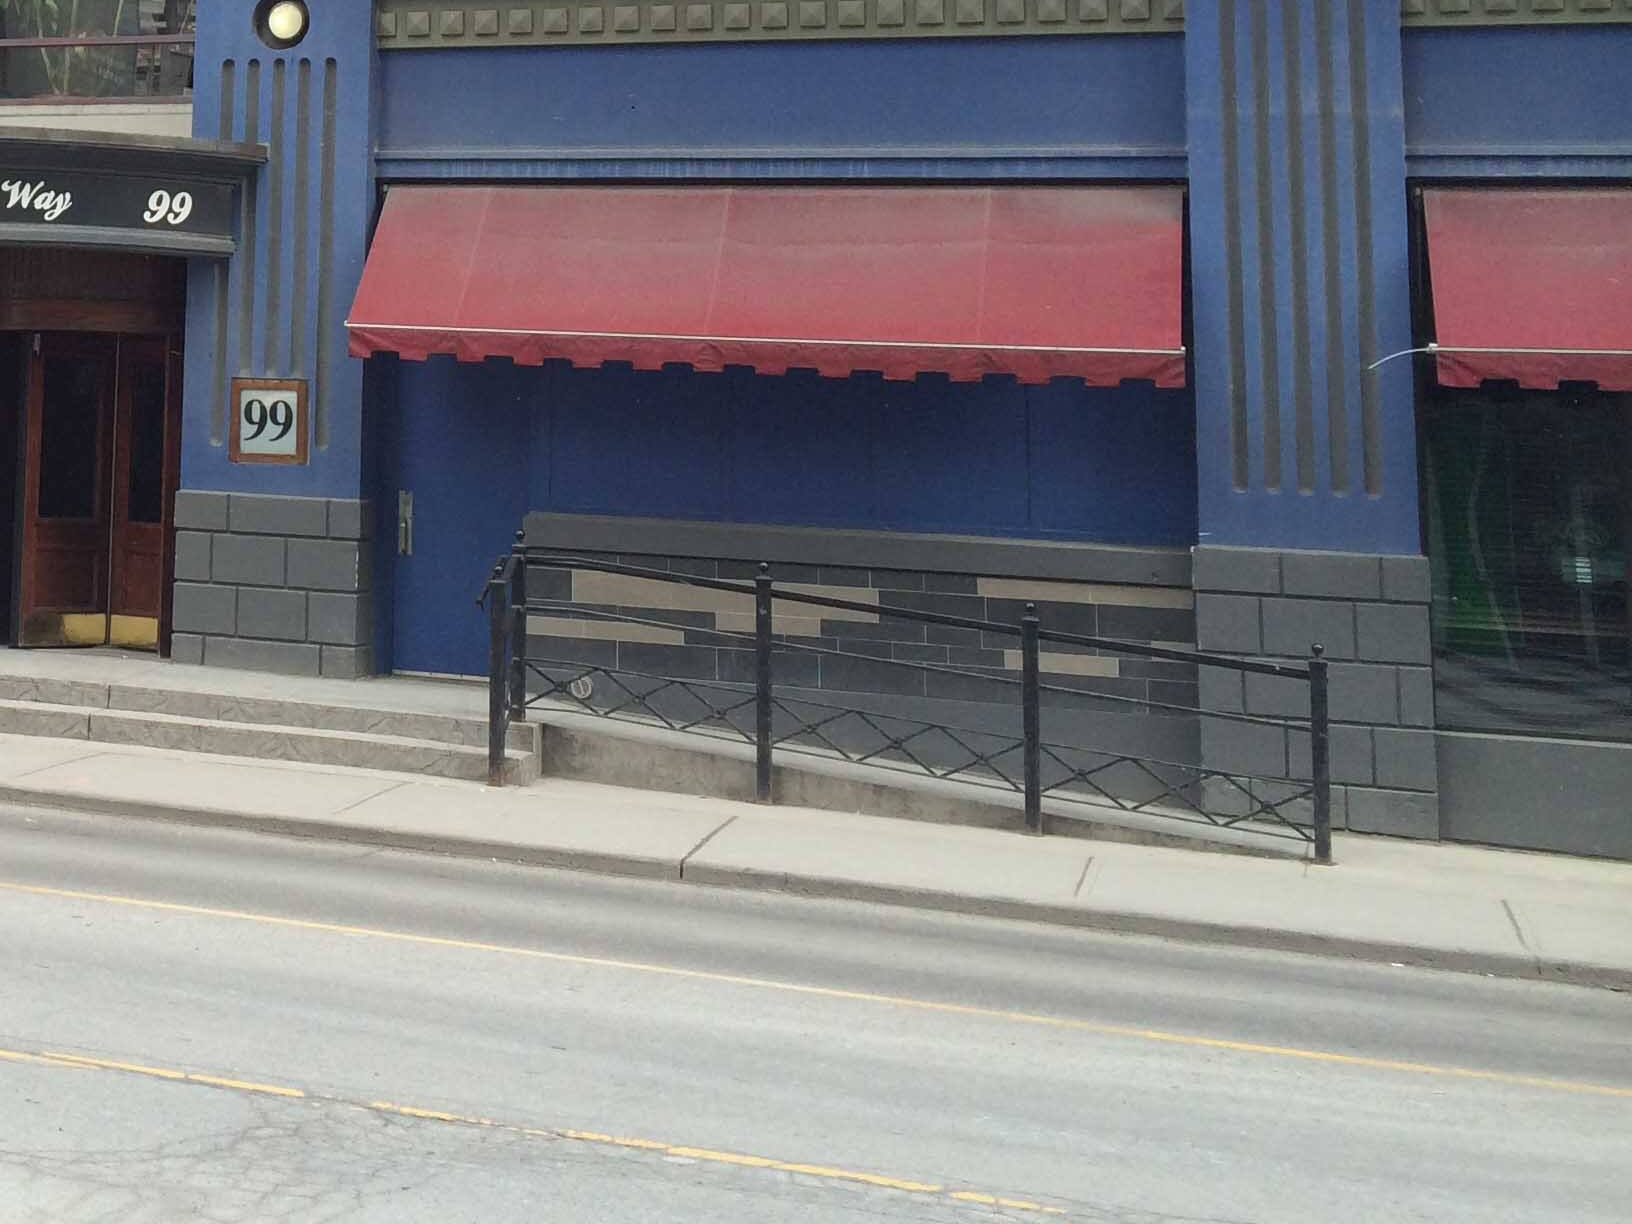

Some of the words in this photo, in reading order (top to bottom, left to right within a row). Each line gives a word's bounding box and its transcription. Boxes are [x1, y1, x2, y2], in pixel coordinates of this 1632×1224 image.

[2, 179, 72, 221] Way
[143, 189, 193, 225] 99
[243, 398, 293, 442] 99
